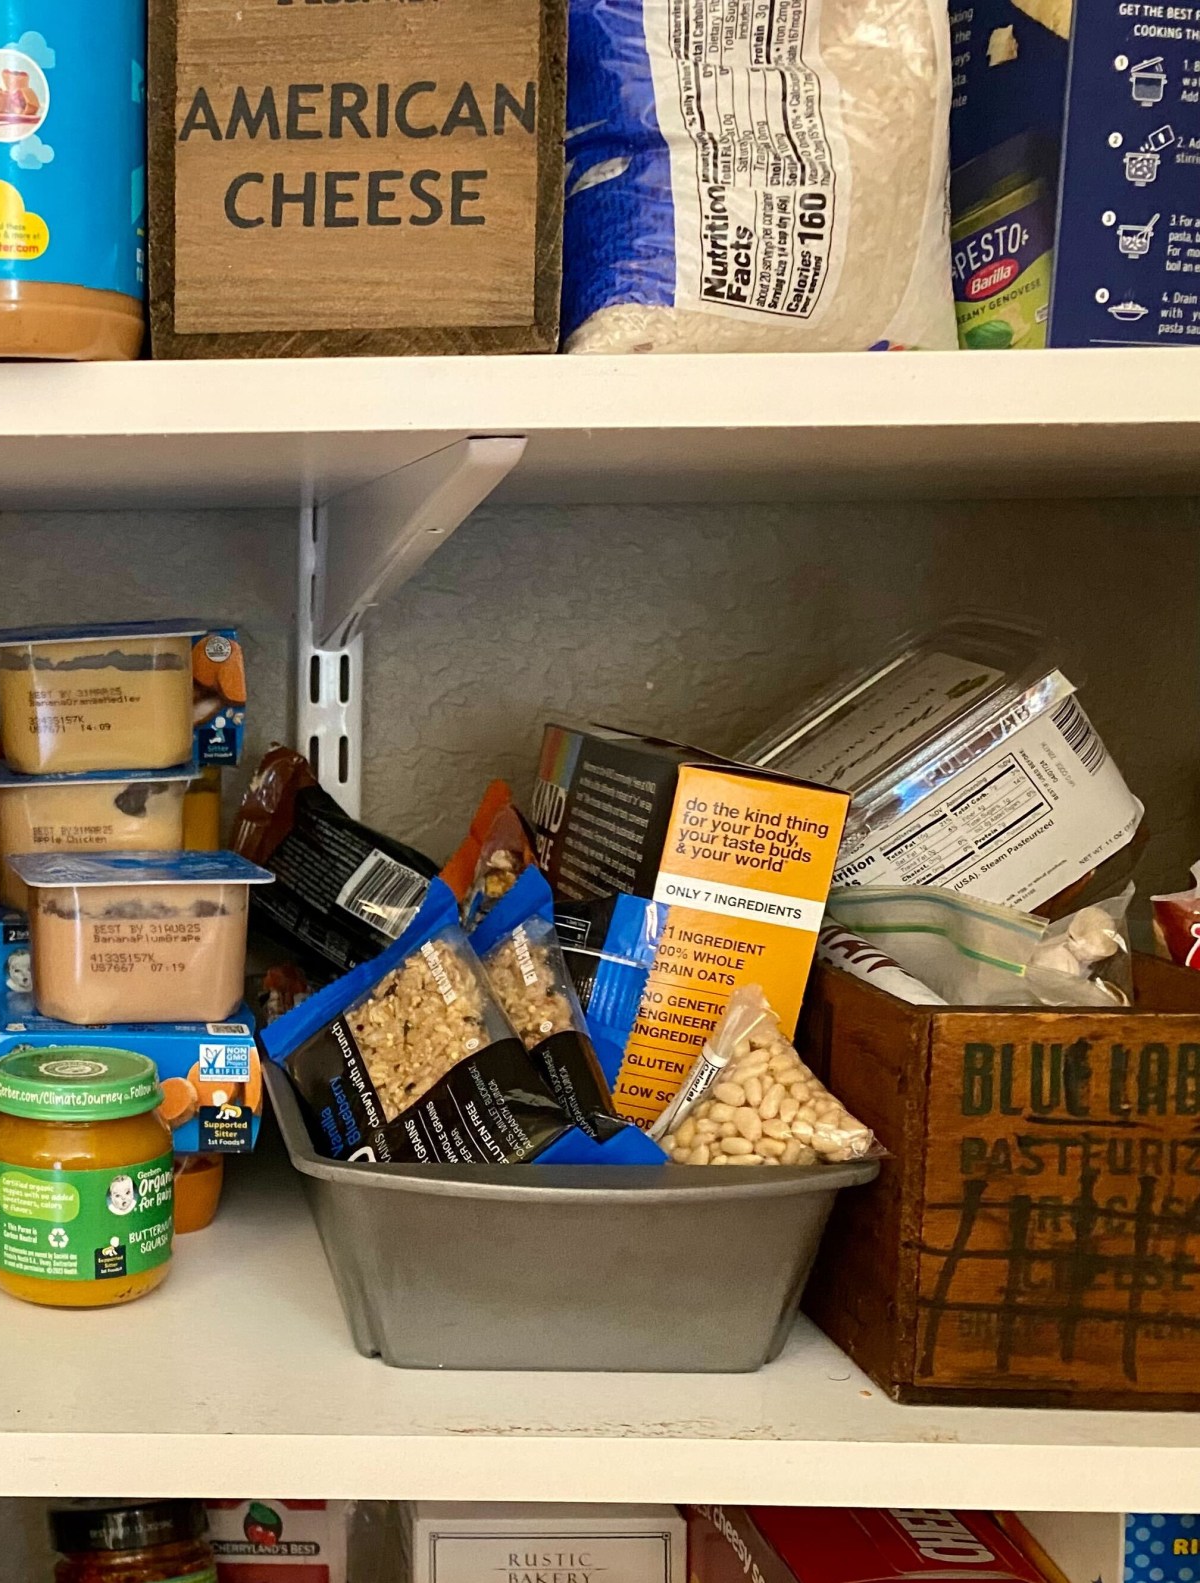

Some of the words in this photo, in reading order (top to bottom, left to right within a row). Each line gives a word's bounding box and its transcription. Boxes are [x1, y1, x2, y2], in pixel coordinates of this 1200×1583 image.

[1119, 4, 1139, 16] GET
[1143, 5, 1164, 18] THE
[1166, 7, 1192, 20] BEST
[753, 24, 766, 64] Protein
[1134, 24, 1182, 40] COOKING
[178, 81, 537, 141] AMERICAN
[224, 169, 488, 228] CHEESE
[703, 185, 730, 300] Nutrition
[786, 251, 812, 314] Calories
[799, 192, 828, 242] 160
[954, 223, 1021, 280] PESTO
[726, 226, 754, 302] Facts
[971, 265, 1012, 294] Barilla
[988, 278, 1041, 310] GENOVESE
[1173, 292, 1198, 304] Drain
[1161, 308, 1182, 319] with
[1158, 323, 1184, 335] pasta
[682, 812, 707, 828] for
[710, 818, 750, 837] your
[754, 822, 800, 847] body,
[686, 796, 708, 813] do
[713, 801, 740, 819] the
[744, 807, 781, 827] kind
[786, 814, 830, 839] thing
[66, 834, 107, 844] Chicken
[678, 828, 722, 846] your
[724, 834, 764, 854] taste
[768, 842, 812, 863] buds
[974, 827, 998, 846] Protein
[980, 848, 1007, 873] Steam
[1006, 819, 1054, 852] Pasteurized
[675, 842, 686, 855] &
[690, 844, 730, 864] your
[734, 848, 784, 873] world
[666, 884, 703, 902] ONLY
[704, 891, 712, 904] 7
[714, 893, 802, 920] INGREDIENTS
[94, 924, 120, 934] BEST
[130, 924, 144, 934] BY
[678, 930, 766, 956] INGREDIENT
[151, 962, 186, 972] 07:19
[651, 960, 694, 978] GRAIN
[697, 969, 736, 986] OATS
[693, 951, 746, 970] WHOLE
[644, 992, 664, 1004] NO
[332, 1021, 354, 1058] crunch
[627, 1053, 685, 1074] GLUTEN
[349, 1068, 366, 1094] with
[961, 1036, 1092, 1118] BLUE
[620, 1083, 654, 1099] LOW
[329, 1075, 362, 1146] Blueberry
[359, 1090, 380, 1127] chewy
[426, 1101, 444, 1132] GRAINS
[465, 1100, 482, 1122] FREE
[204, 1120, 248, 1130] Supported
[214, 1130, 238, 1138] Sitter
[322, 1104, 342, 1158] Vanilla
[404, 1120, 427, 1160] GRAINS
[138, 1166, 162, 1180] Gerber
[138, 1196, 154, 1212] for
[289, 1543, 316, 1555] BEST
[714, 1507, 752, 1565] cheesy
[508, 1552, 593, 1567] RUSTIC
[508, 1572, 593, 1583] BAKERY
